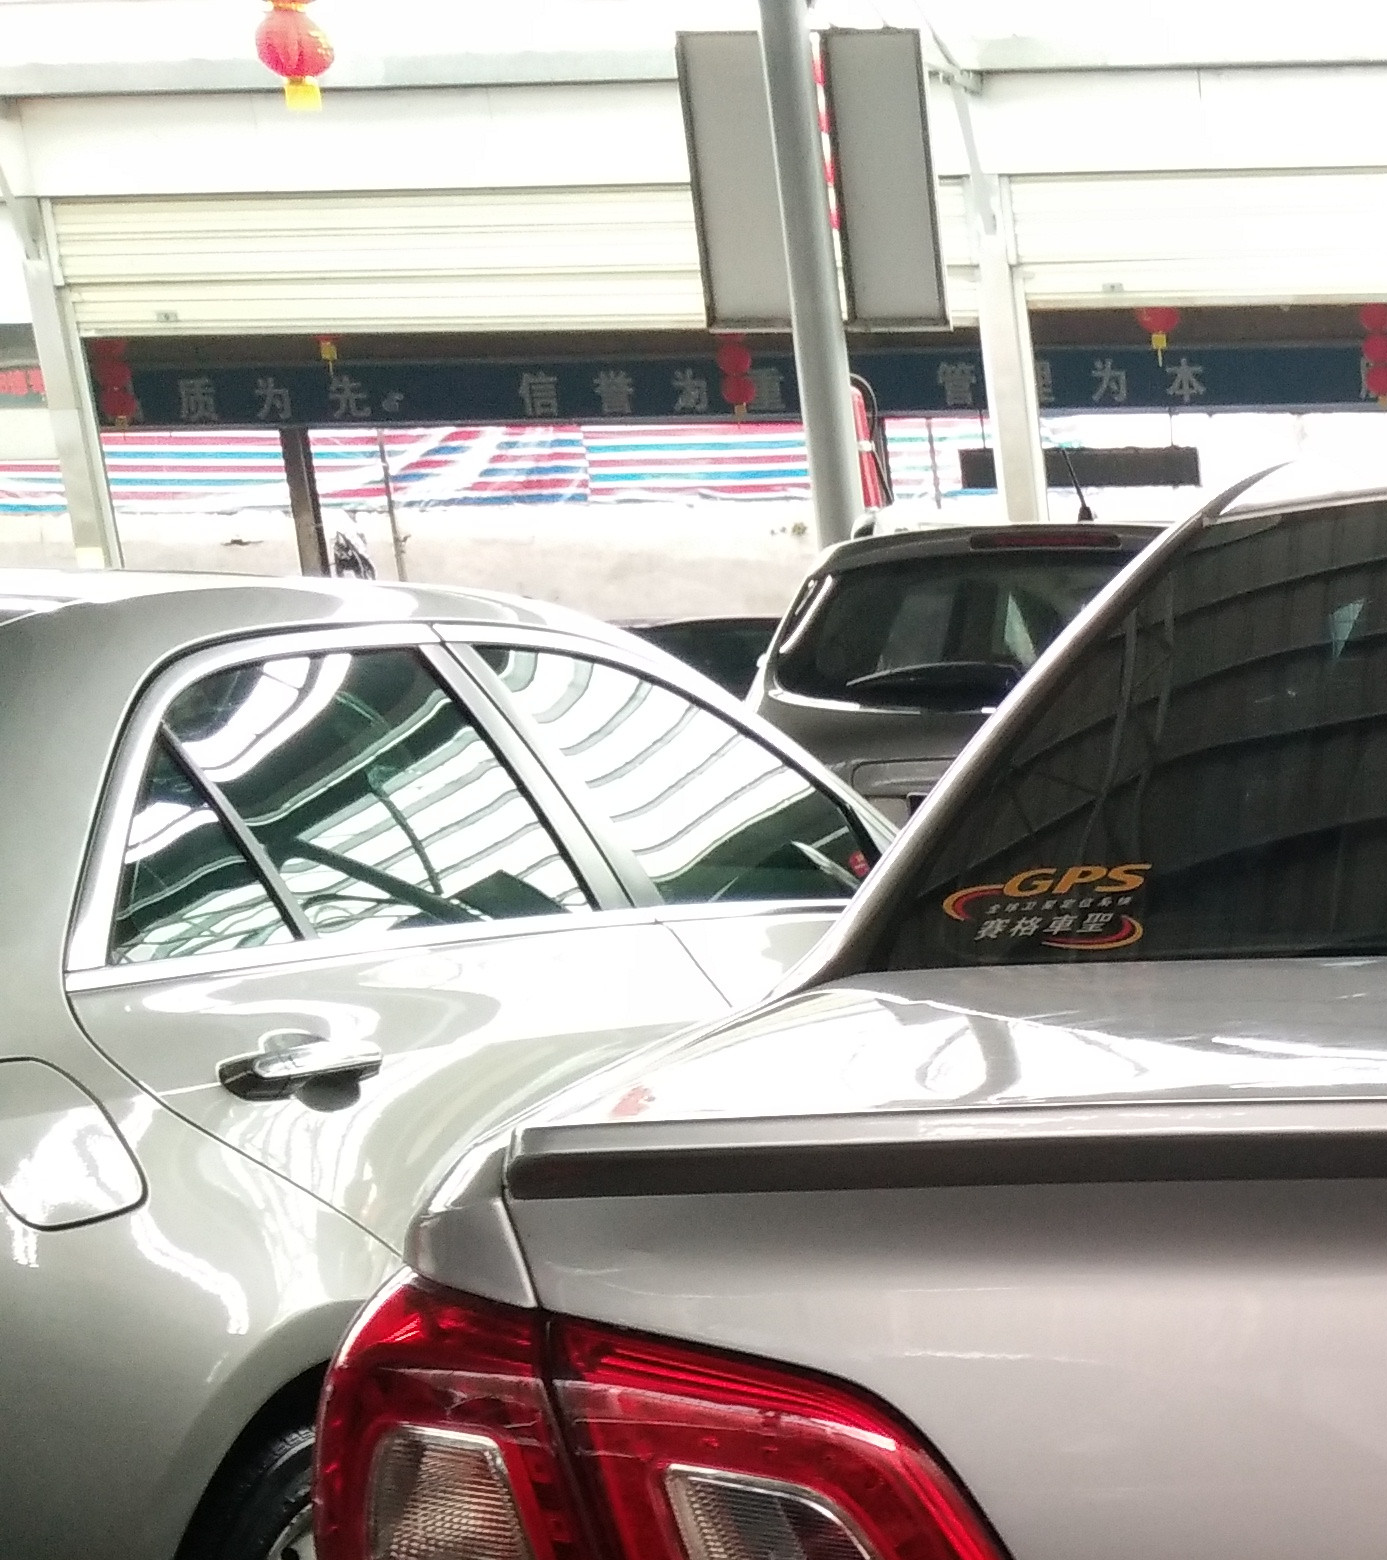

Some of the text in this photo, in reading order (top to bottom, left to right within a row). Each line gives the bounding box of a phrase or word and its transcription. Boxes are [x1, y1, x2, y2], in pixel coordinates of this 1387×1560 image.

[101, 374, 372, 422] 质为先
[519, 367, 787, 417] 信誉为重
[1002, 862, 1152, 898] GPS
